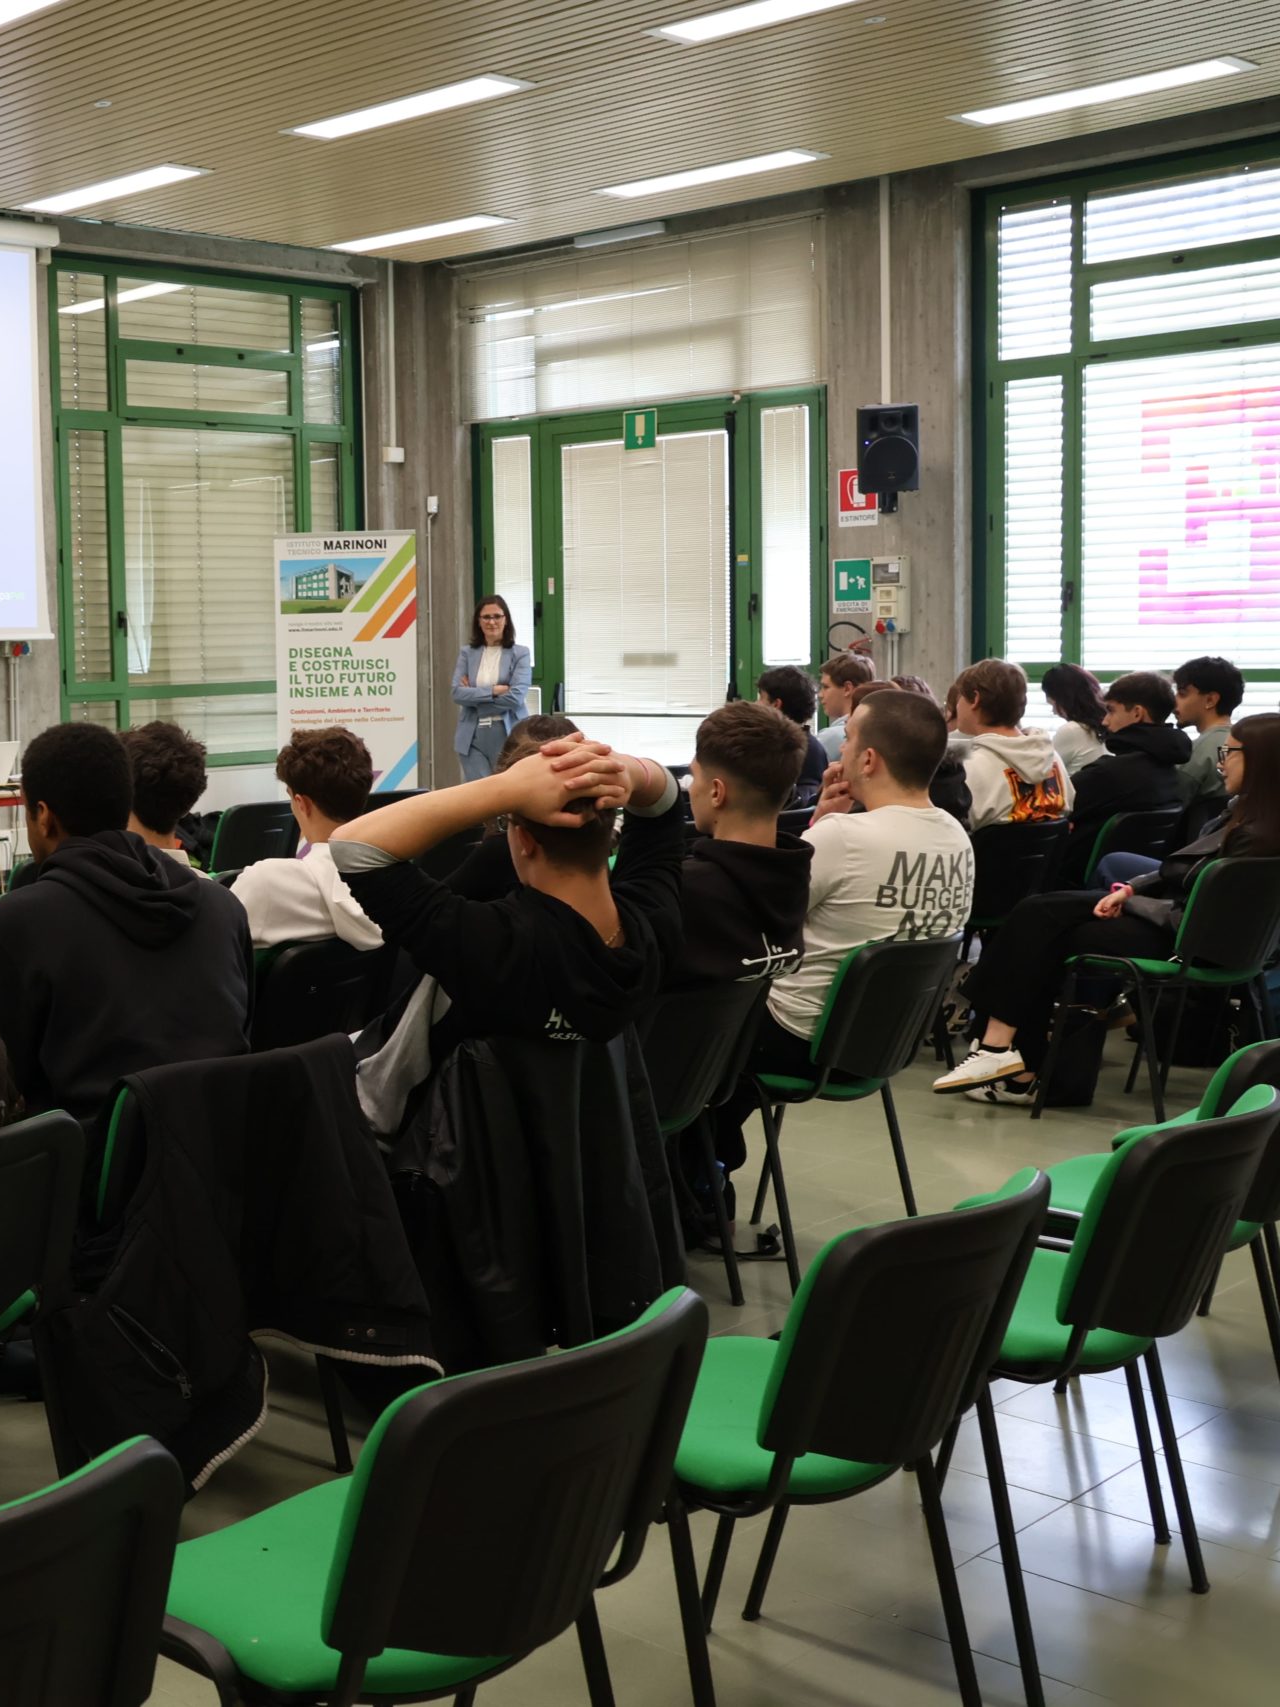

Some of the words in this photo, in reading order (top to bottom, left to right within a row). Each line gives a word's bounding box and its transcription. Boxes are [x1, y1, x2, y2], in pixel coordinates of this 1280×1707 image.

[841, 514, 877, 522] ESTINTORE
[323, 539, 387, 550] MARINONI
[289, 646, 353, 659] DISEGNA
[289, 661, 297, 672] E
[302, 659, 389, 671] COSTRUISCI
[289, 674, 302, 685] IL
[306, 673, 335, 684] TUO
[339, 671, 397, 684] FUTURO
[289, 686, 349, 698] INSIEME
[354, 686, 363, 697] A
[367, 685, 393, 696] NOI
[887, 847, 973, 887] MAKE
[884, 906, 970, 941] NOT
